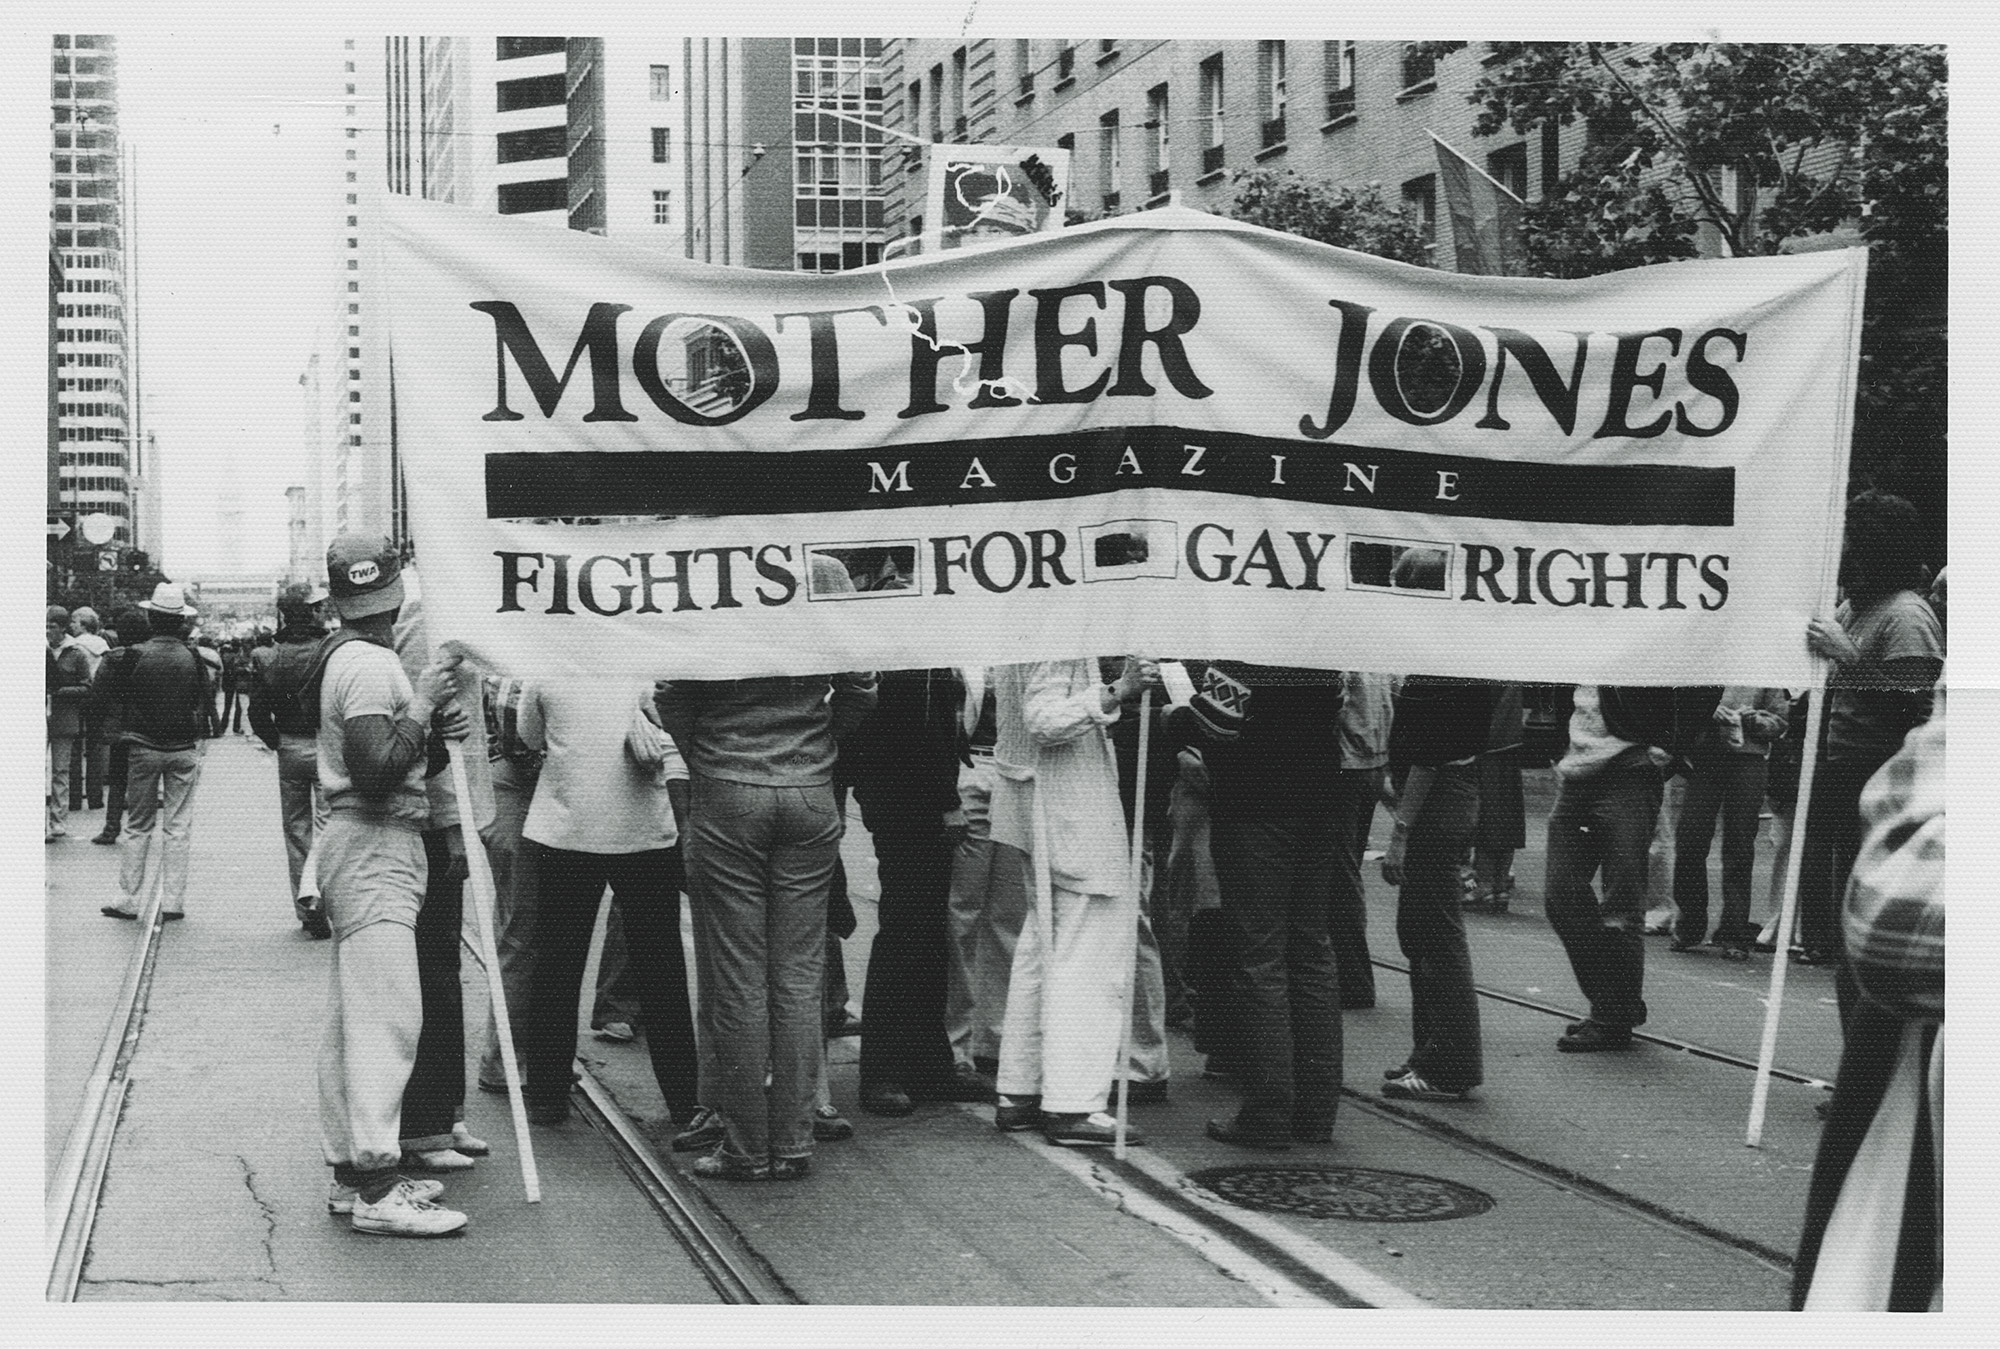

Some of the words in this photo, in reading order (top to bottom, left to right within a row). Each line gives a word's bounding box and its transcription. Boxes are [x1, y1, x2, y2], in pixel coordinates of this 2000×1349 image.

[470, 275, 1213, 424] MOTHER
[1299, 300, 1748, 440] JONES
[868, 444, 1460, 501] MAGAZINE
[350, 566, 377, 579] TWA
[493, 543, 801, 618] FIGHTS
[928, 529, 1077, 596] FOR
[1185, 523, 1337, 592] GAY
[1460, 542, 1731, 613] RIGHTS
